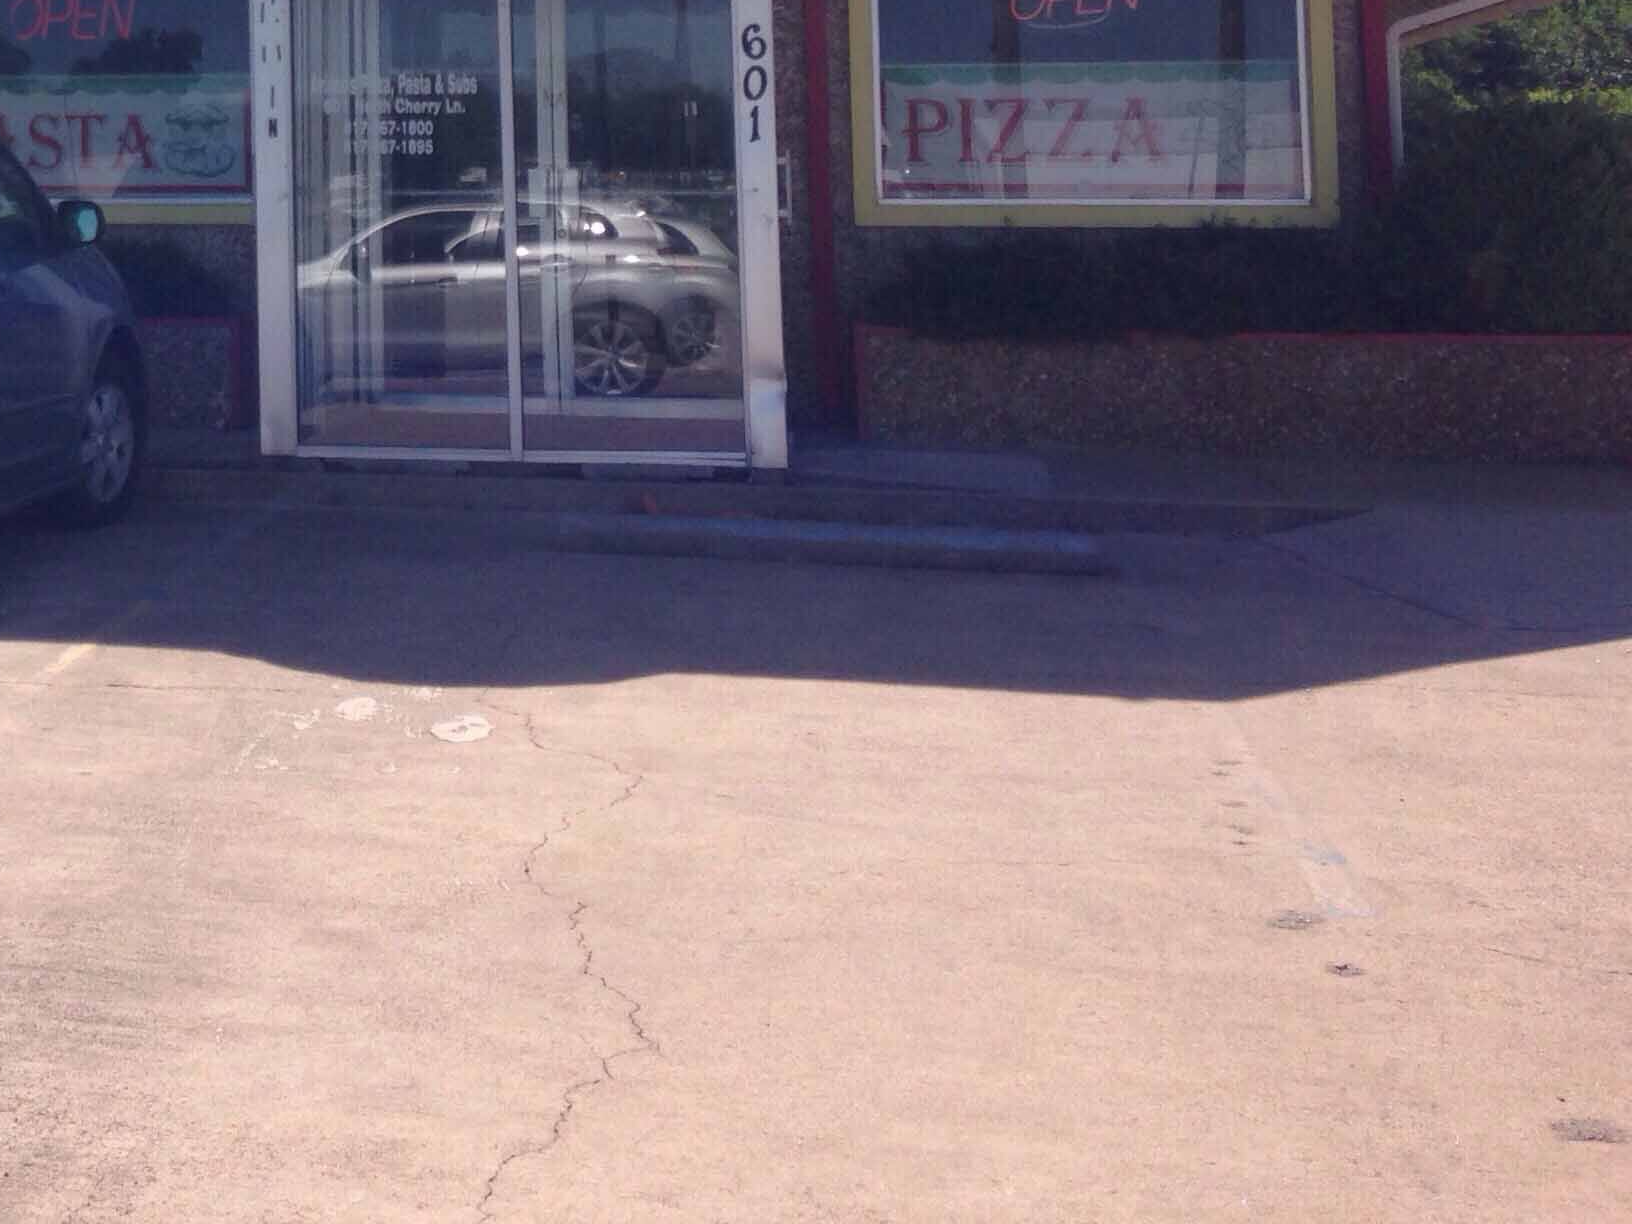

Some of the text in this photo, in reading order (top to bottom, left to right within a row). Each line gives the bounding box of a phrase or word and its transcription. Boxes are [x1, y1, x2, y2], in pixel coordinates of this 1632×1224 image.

[394, 97, 441, 116] Cherry
[397, 73, 432, 95] Pasta
[435, 75, 445, 95] &
[447, 72, 478, 95] Subs
[741, 23, 768, 144] 601
[902, 95, 1166, 167] PIZZA
